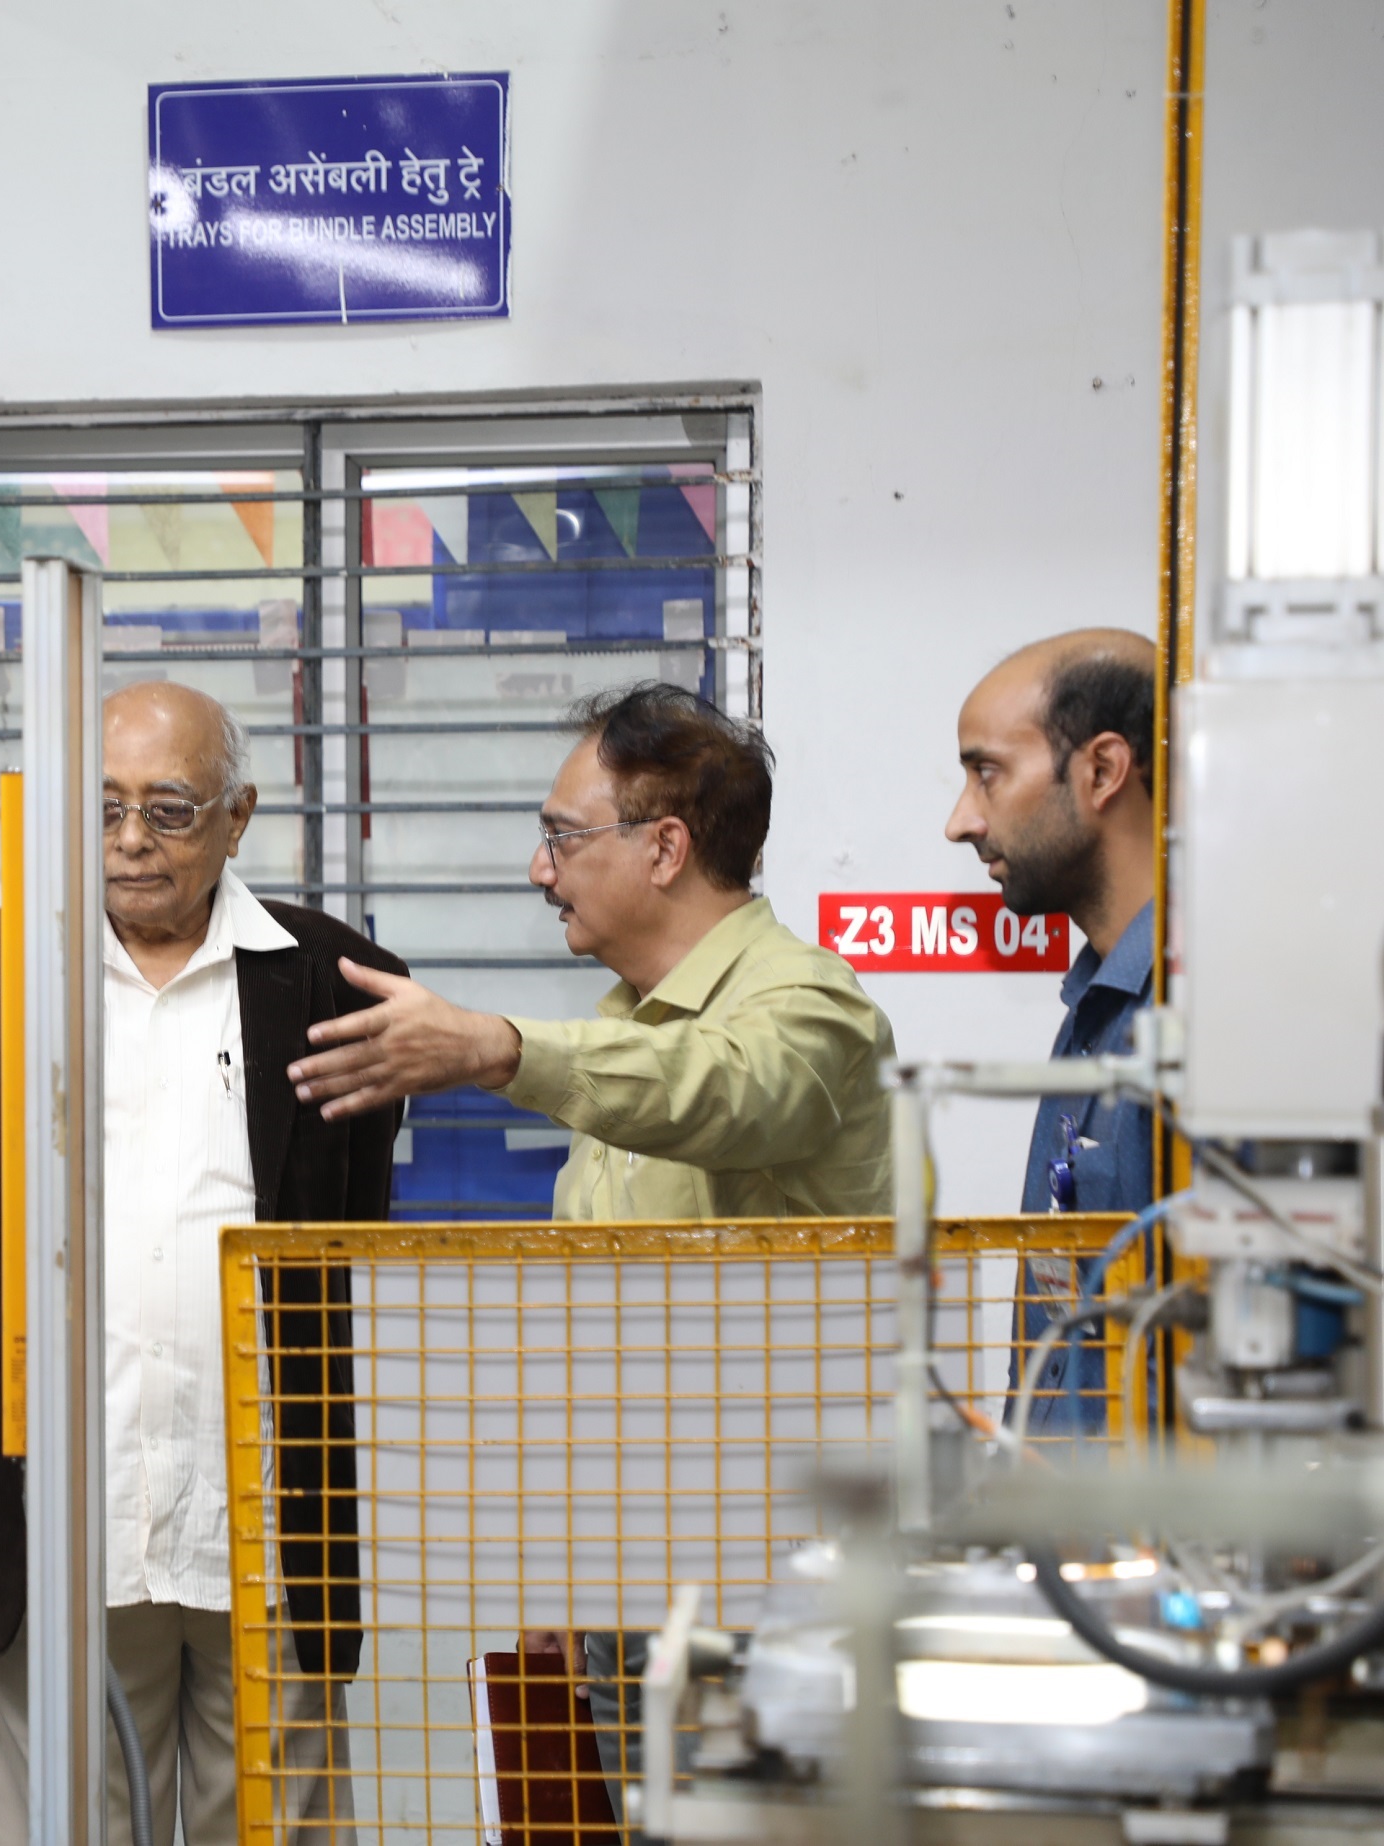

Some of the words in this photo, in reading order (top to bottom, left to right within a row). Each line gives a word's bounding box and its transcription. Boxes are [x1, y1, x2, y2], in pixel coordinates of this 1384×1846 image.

[181, 157, 261, 199] बंडल
[268, 149, 392, 195] असेंबली
[399, 147, 451, 206] हेतु
[457, 145, 485, 200] ट्रे
[168, 220, 233, 249] TRAYS
[239, 217, 283, 247] FOR
[289, 215, 376, 242] BUNDLE
[381, 211, 497, 241] ASSEMBLY
[837, 905, 896, 956] Z3
[911, 905, 979, 956] MS
[994, 906, 1049, 957] 04
